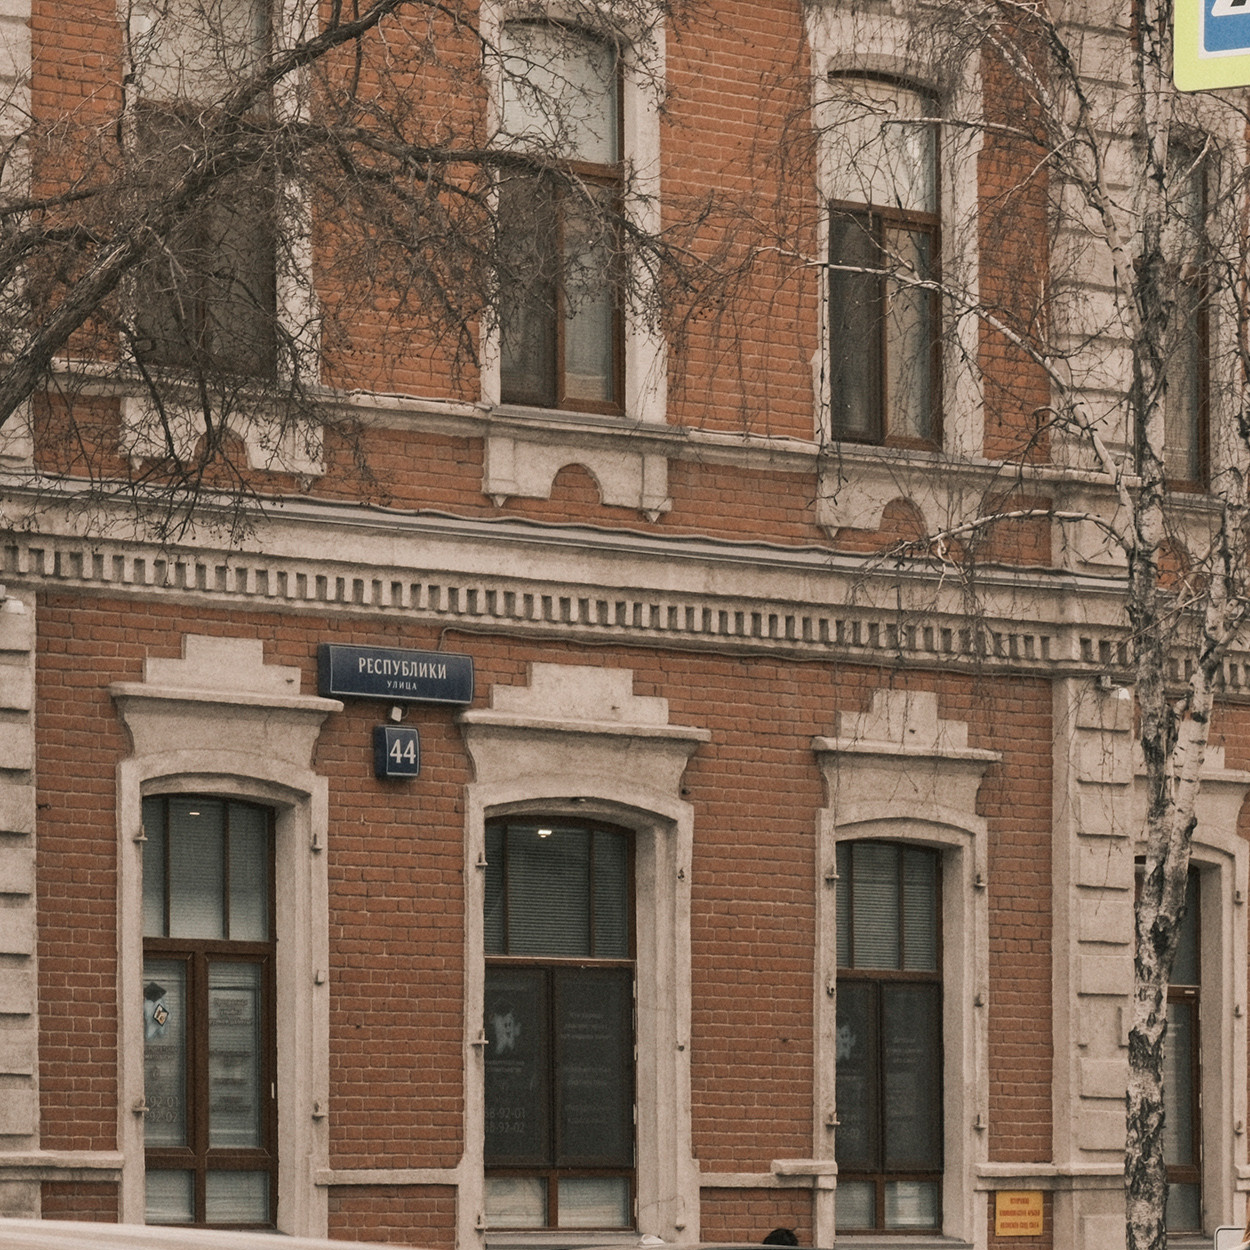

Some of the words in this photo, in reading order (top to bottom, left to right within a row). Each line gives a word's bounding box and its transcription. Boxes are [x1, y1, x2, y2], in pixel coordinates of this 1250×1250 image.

[358, 657, 447, 680] РЕСПУБЛИКИ
[387, 680, 418, 690] УЛИЦА
[389, 739, 416, 764] 44
